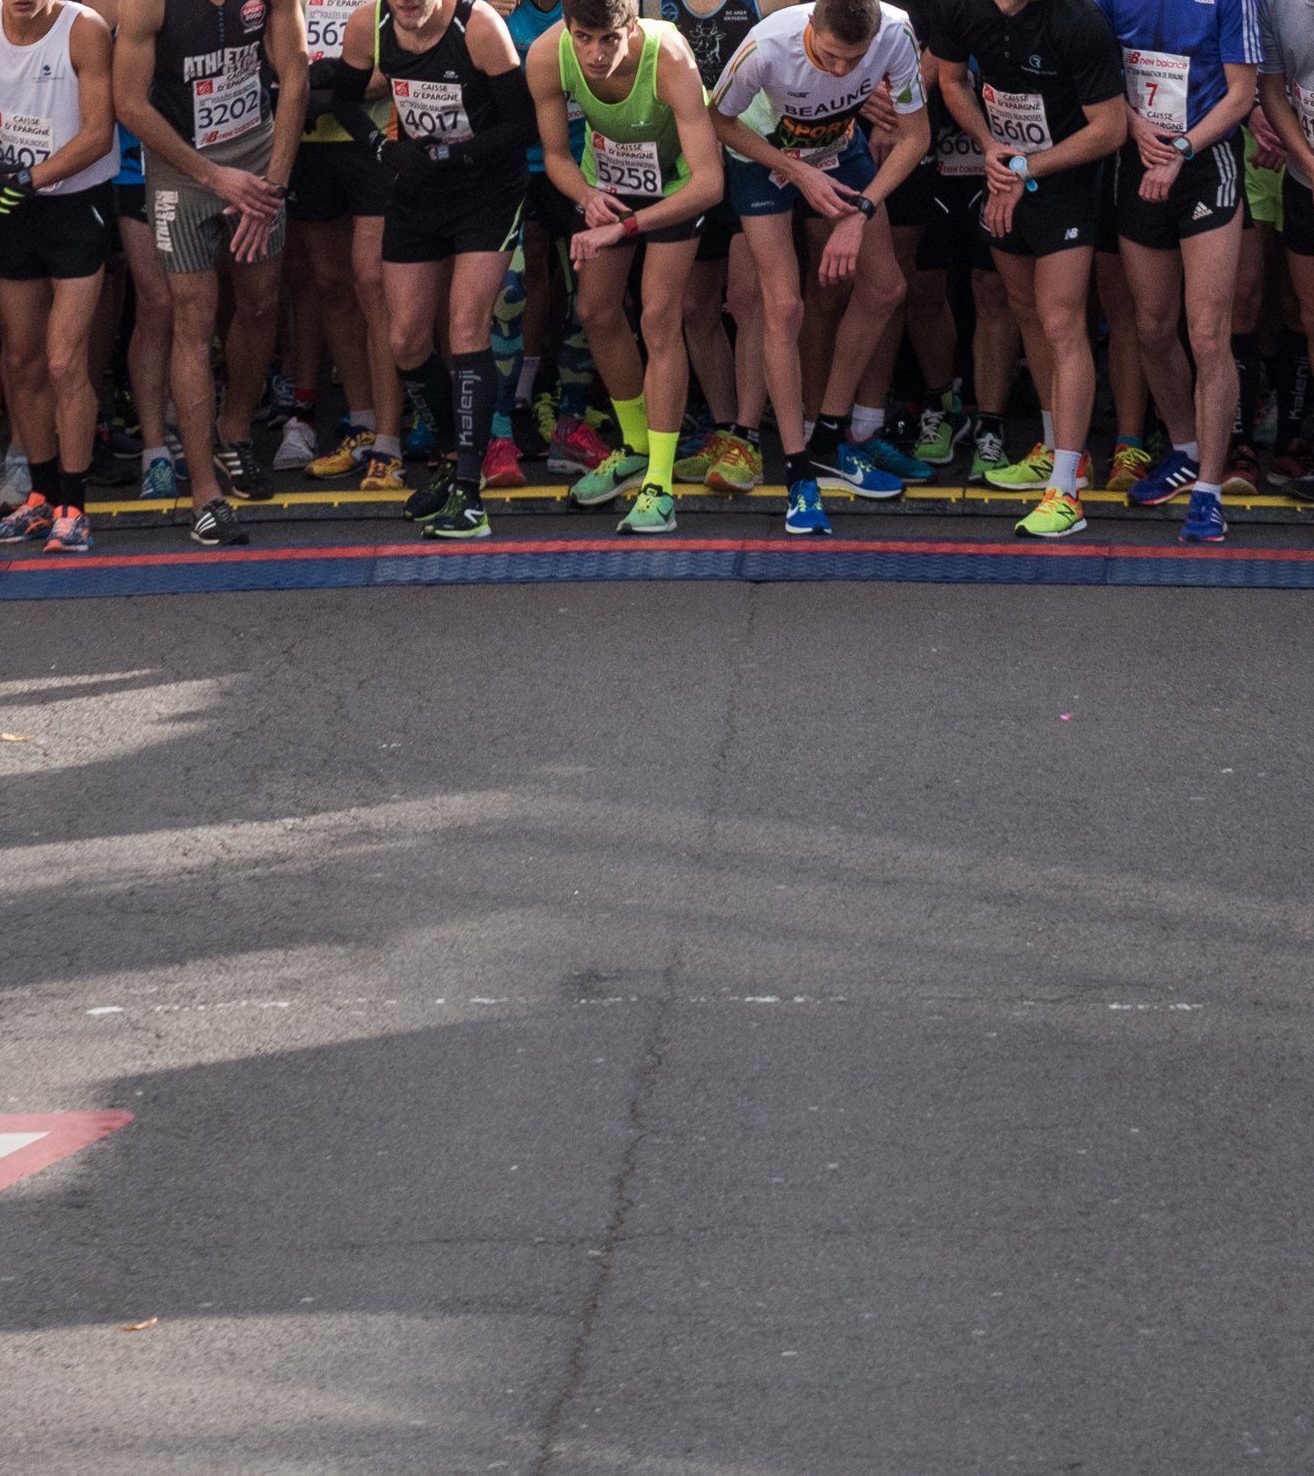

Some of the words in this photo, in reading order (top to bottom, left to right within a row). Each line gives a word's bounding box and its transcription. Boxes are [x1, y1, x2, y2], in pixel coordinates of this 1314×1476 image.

[1140, 57, 1155, 65] new
[1156, 56, 1188, 70] balance
[421, 83, 447, 92] CAISSE
[784, 78, 874, 117] BEAUNE
[1003, 94, 1029, 102] CAISSE
[1145, 82, 1158, 107] 7
[13, 115, 41, 126] CAISSE
[198, 90, 259, 130] 3202
[405, 109, 460, 134] 4017
[1147, 111, 1173, 120] CAISSE
[990, 114, 1045, 145] 5610
[598, 161, 658, 193] 5258
